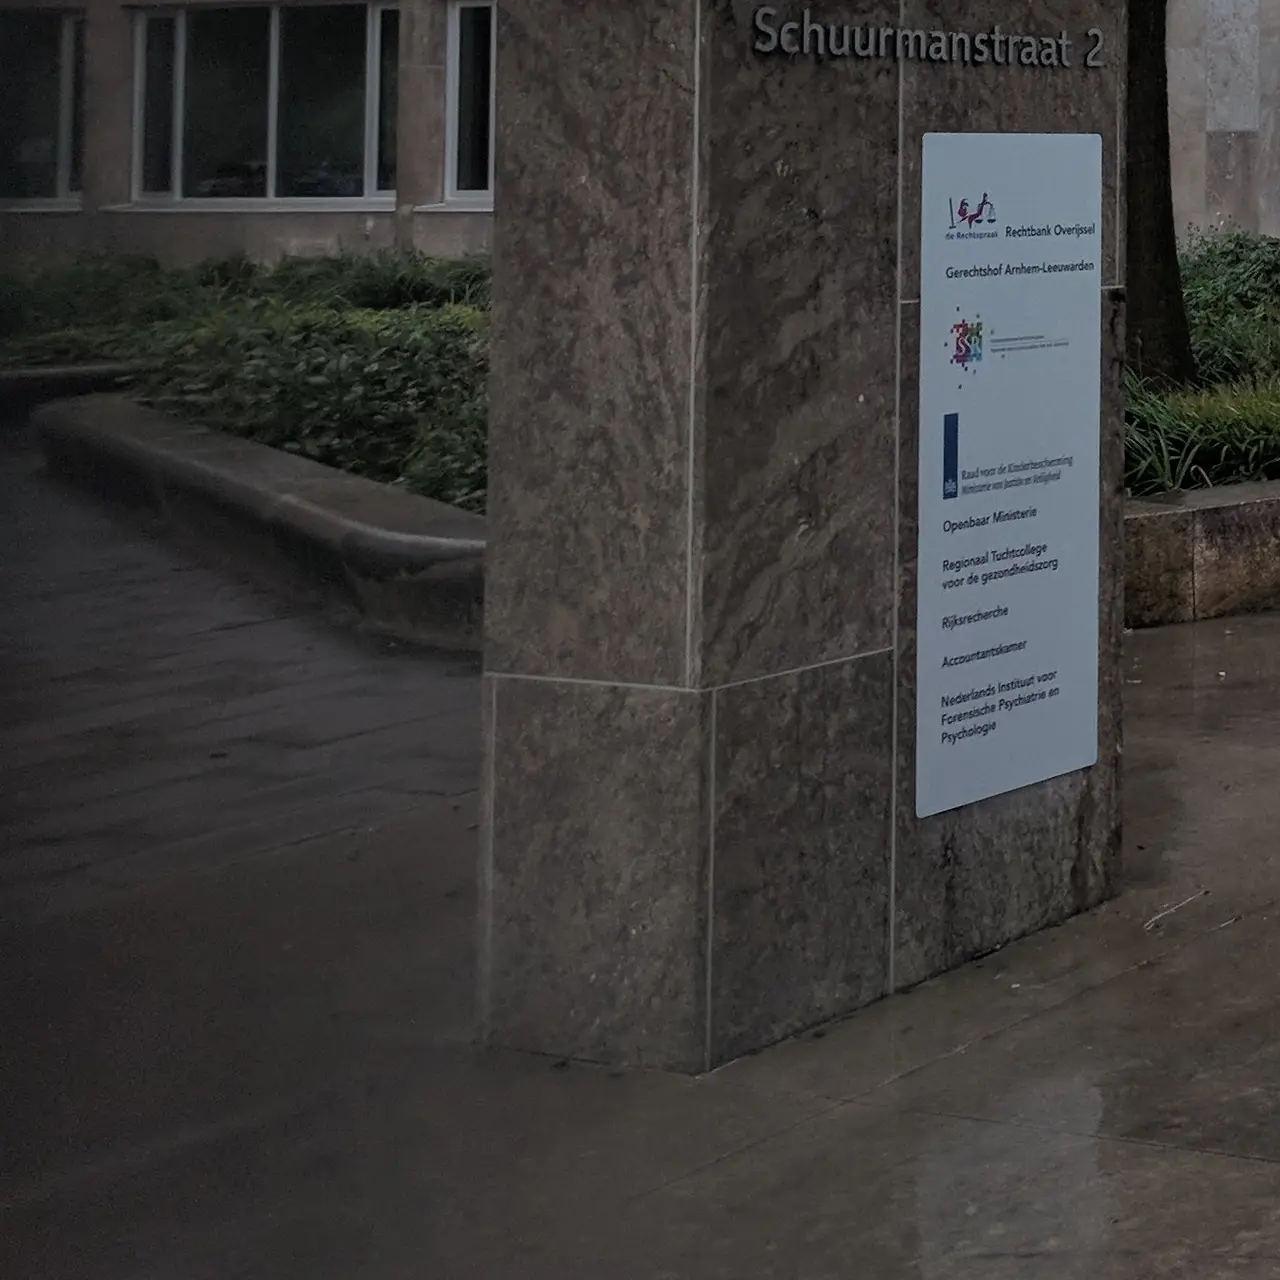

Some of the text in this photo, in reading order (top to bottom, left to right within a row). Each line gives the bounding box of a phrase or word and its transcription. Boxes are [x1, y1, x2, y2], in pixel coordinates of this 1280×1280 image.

[753, 6, 1105, 68] Schuurmanstraat 2
[1005, 224, 1095, 238] Rechtbank Overijssel
[945, 260, 1094, 279] Gerechtshof Arnhem-Leeuwarden
[943, 506, 1037, 534] Openbaar Ministerie
[942, 542, 1047, 573] Regionaal Tuchtcollege
[942, 558, 1058, 589] voor de gezondheidszorg
[941, 605, 1009, 630] Rijksrecherche
[941, 640, 1027, 668] Accountantskamer
[941, 670, 1057, 708] Nederlands Instituut voor
[941, 687, 1060, 726] Forensische Psychiatrie en
[941, 721, 996, 745] Psychologie
